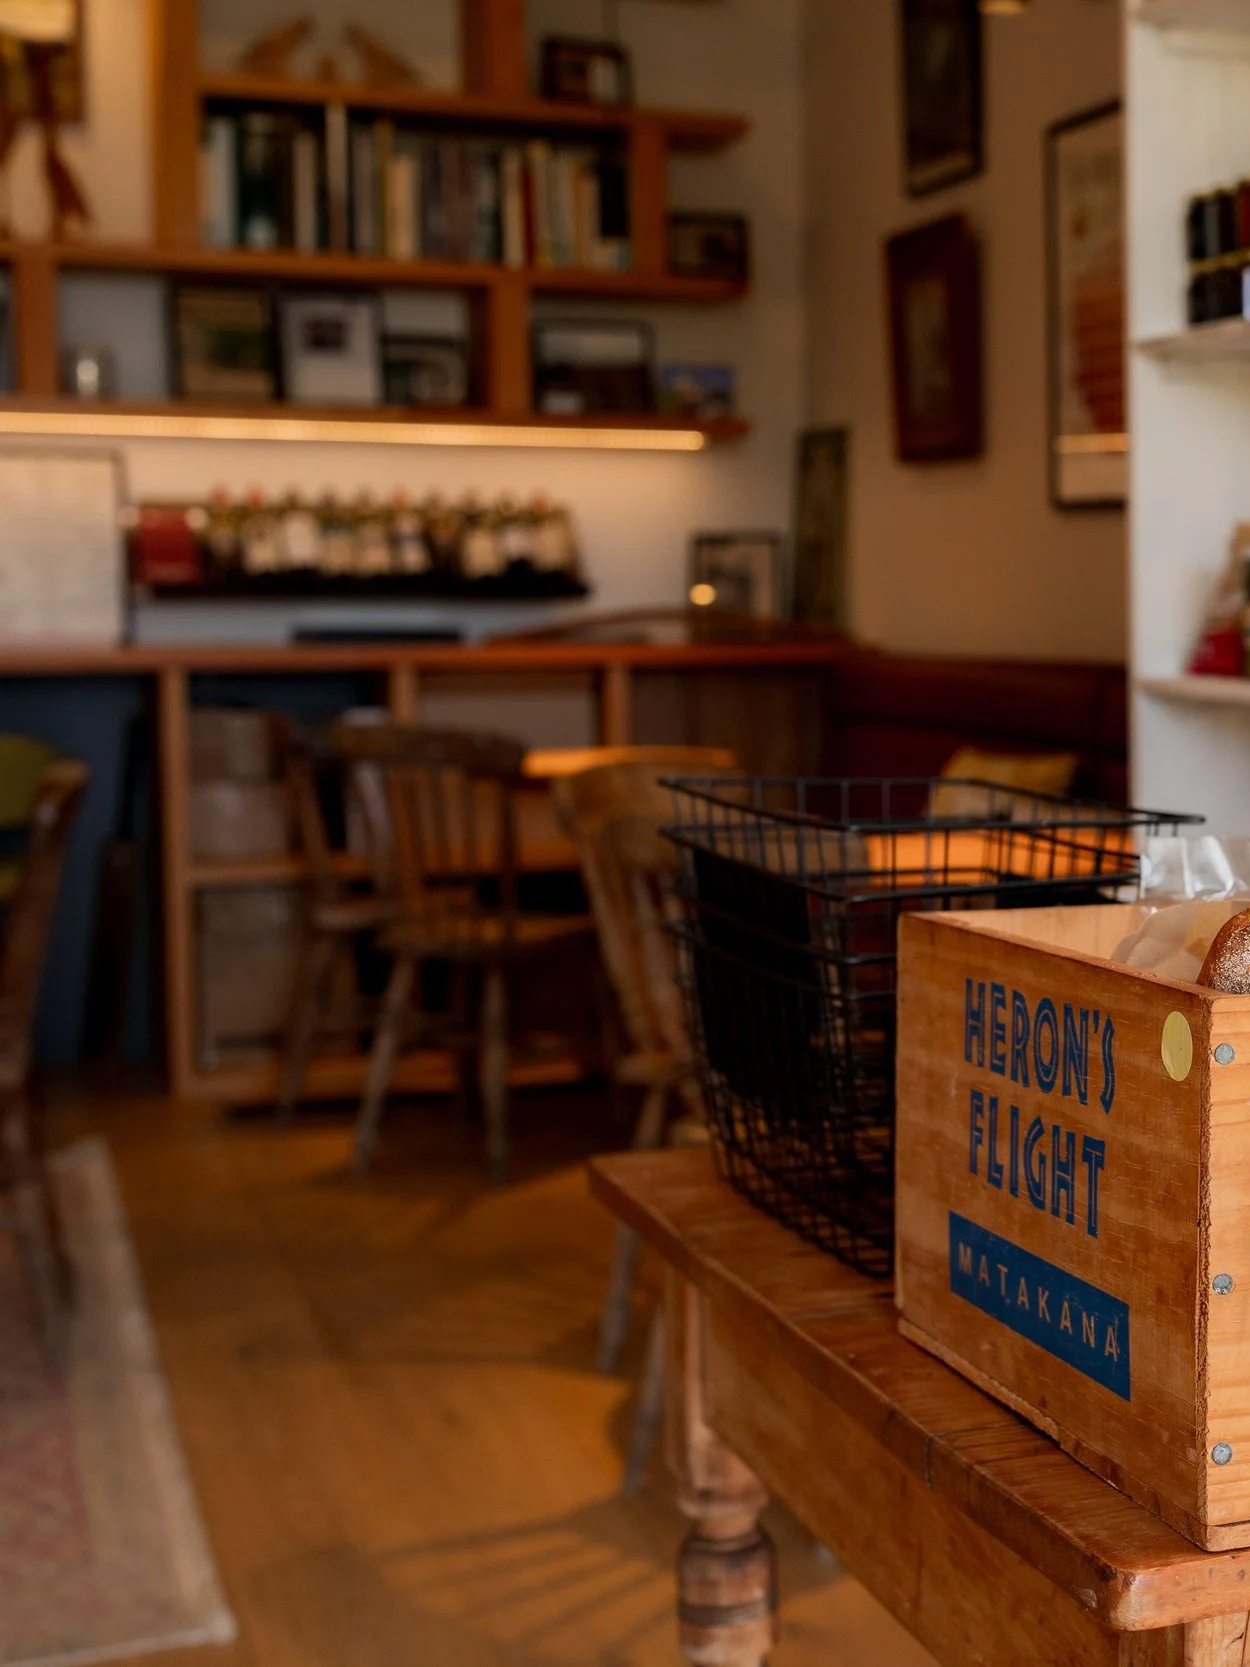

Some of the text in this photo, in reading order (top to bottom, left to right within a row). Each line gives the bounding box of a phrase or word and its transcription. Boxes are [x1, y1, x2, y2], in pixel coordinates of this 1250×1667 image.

[963, 977, 1116, 1116] HERON'S
[968, 1088, 1107, 1239] FLIGHT
[957, 1241, 1120, 1363] MATAKANA
